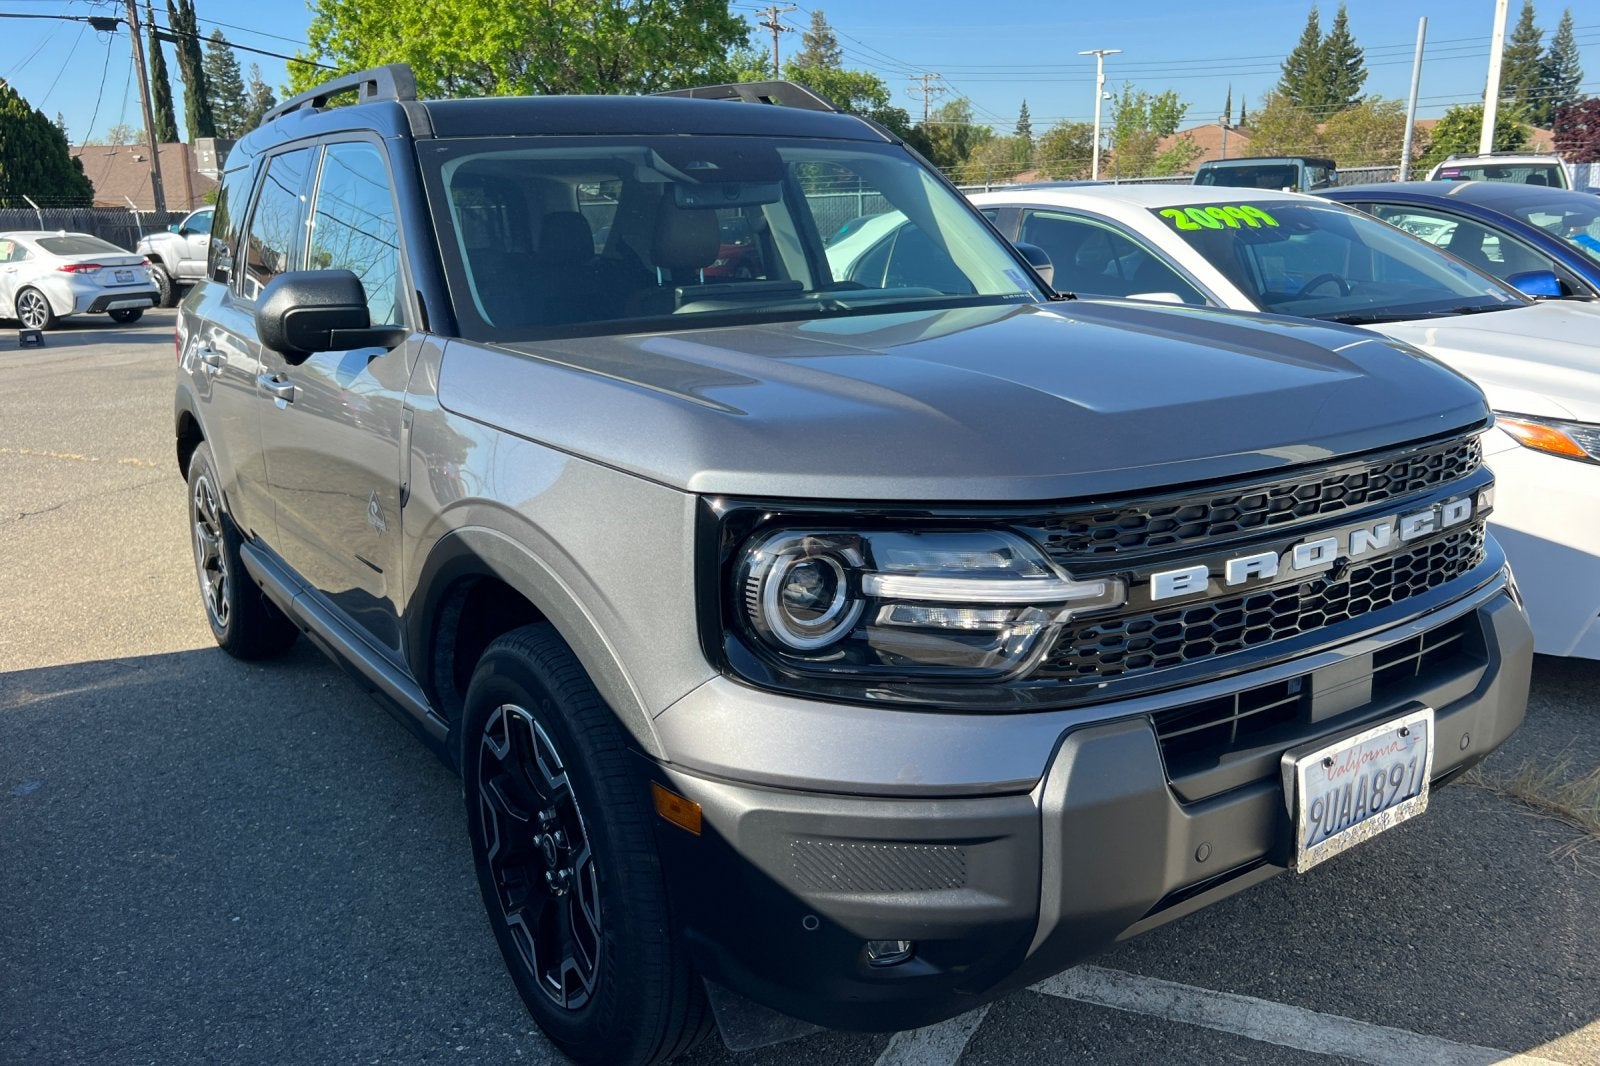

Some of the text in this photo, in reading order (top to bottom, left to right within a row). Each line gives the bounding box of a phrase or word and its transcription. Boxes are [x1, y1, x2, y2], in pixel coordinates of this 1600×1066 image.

[1160, 205, 1280, 230] 20999
[1151, 497, 1472, 601] BRONCO
[1327, 741, 1407, 781] California
[1307, 756, 1418, 848] 9UAA891
